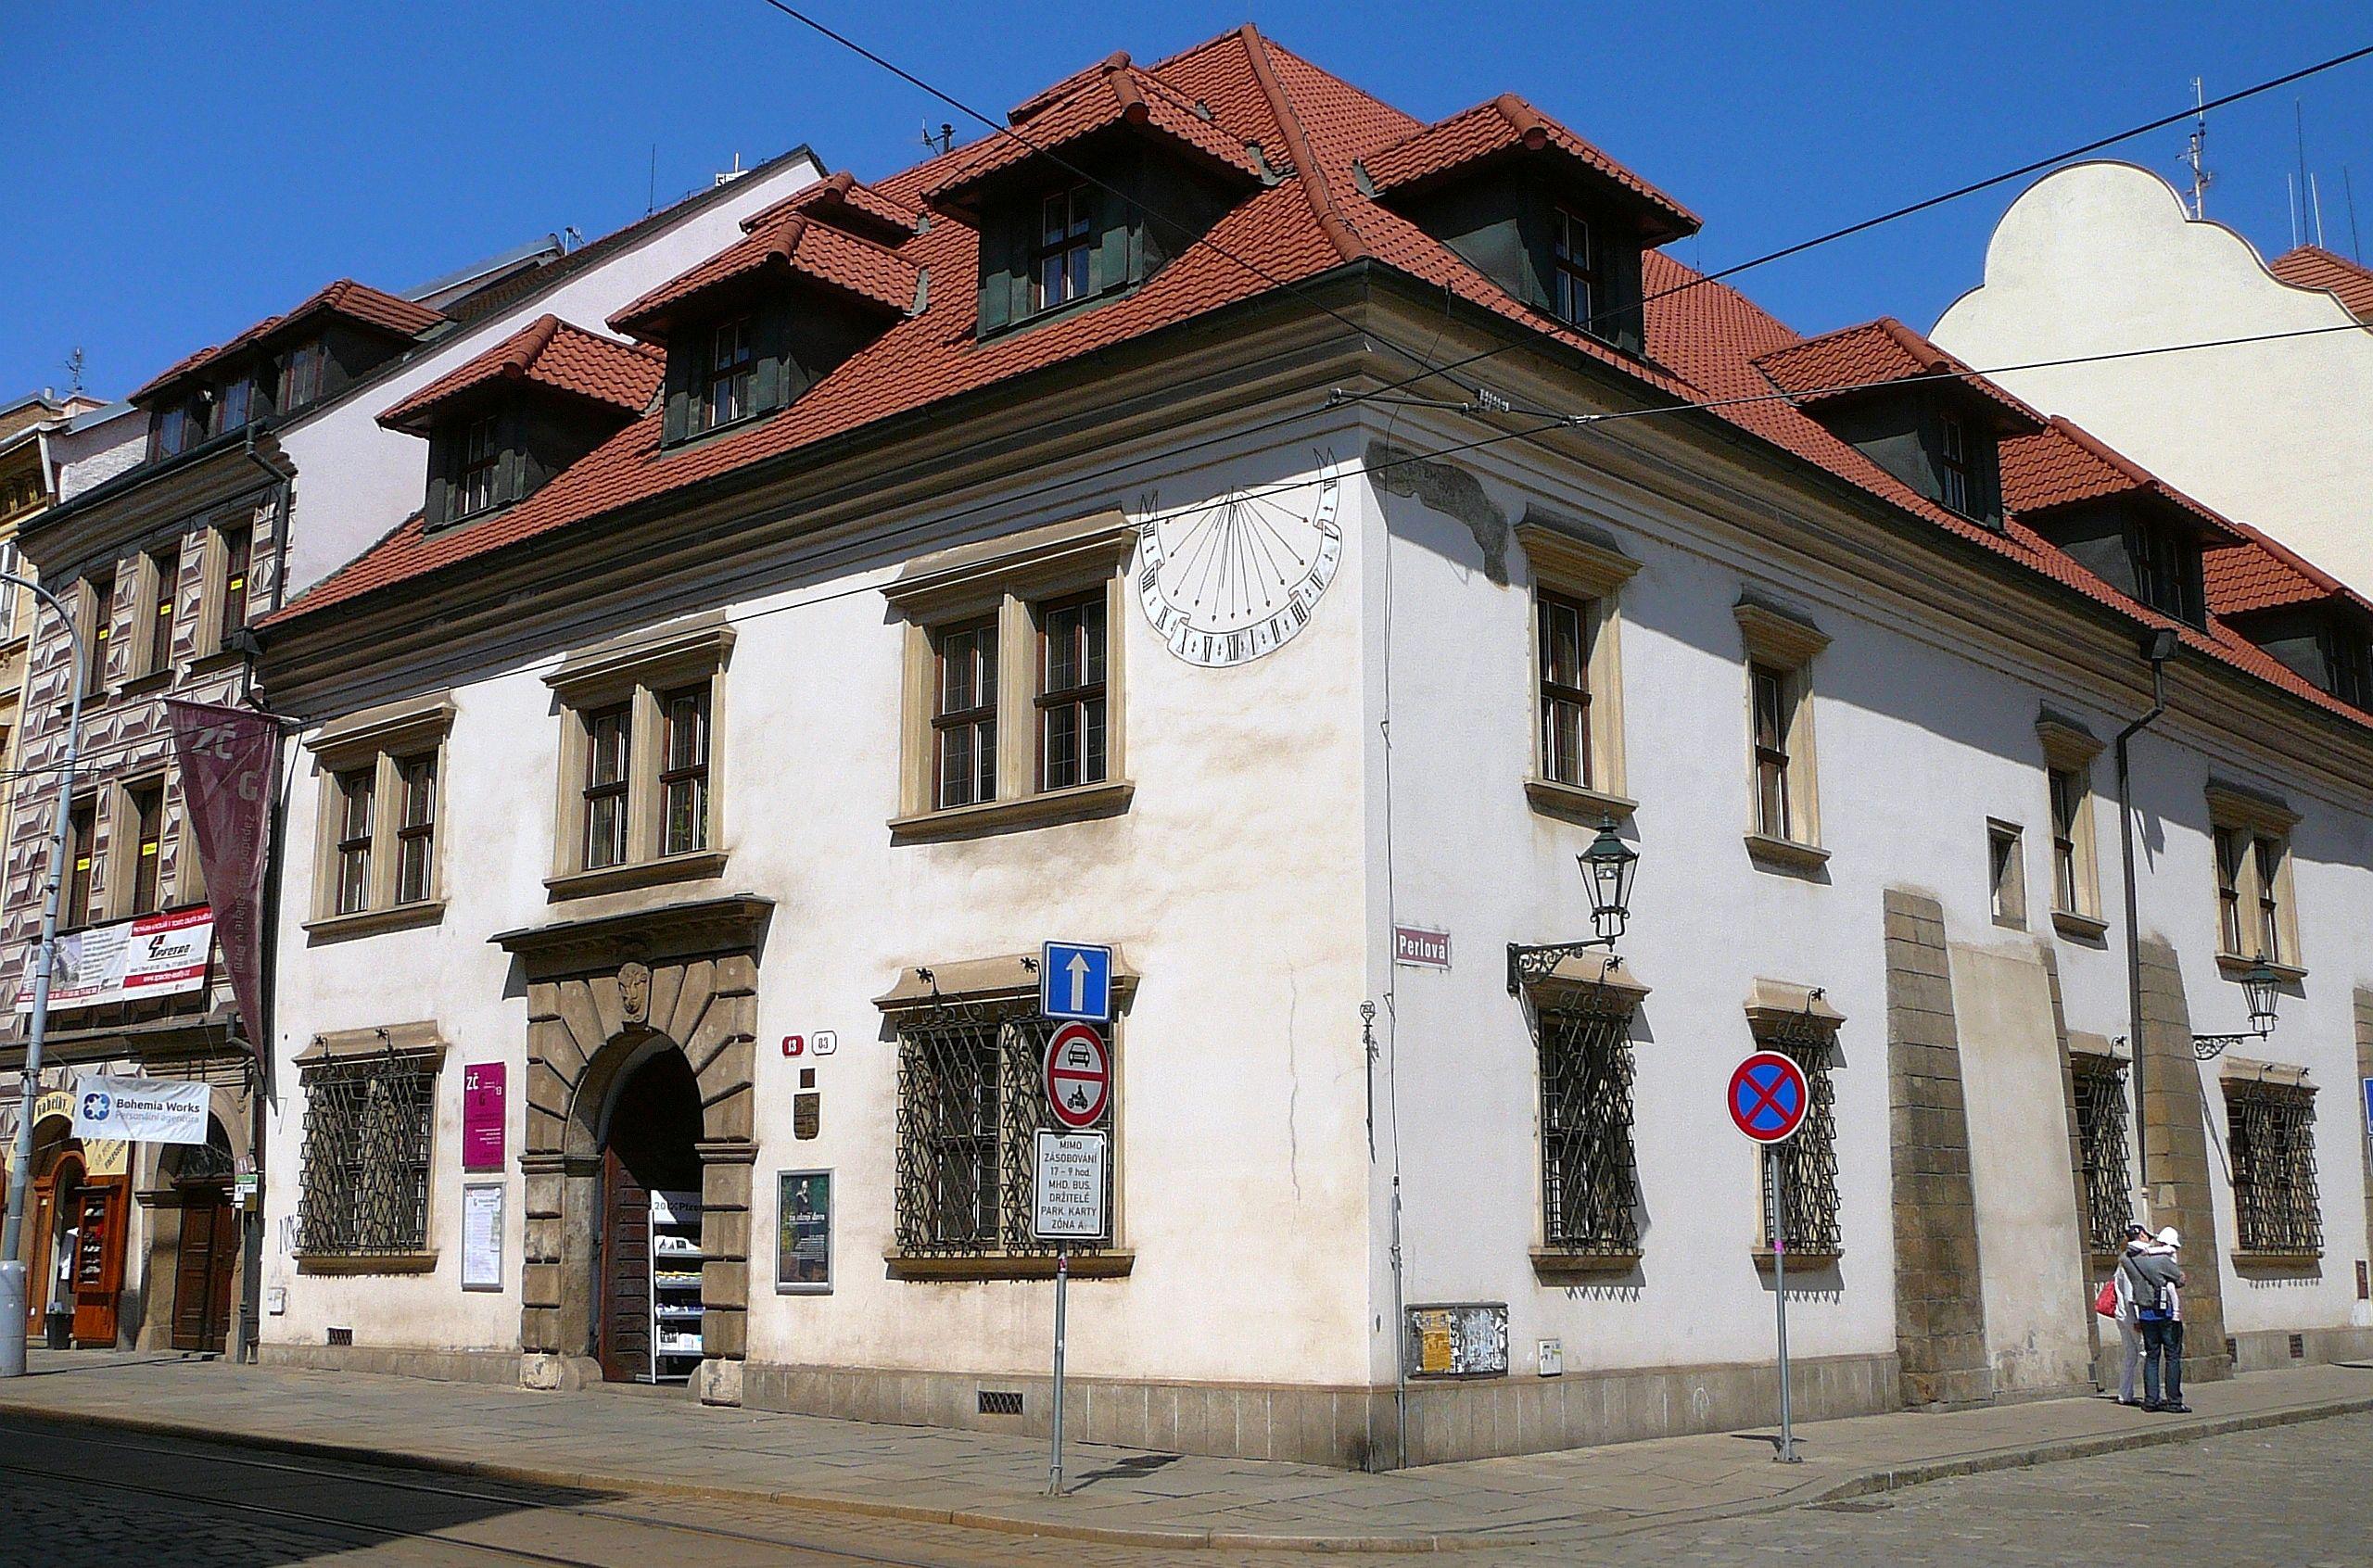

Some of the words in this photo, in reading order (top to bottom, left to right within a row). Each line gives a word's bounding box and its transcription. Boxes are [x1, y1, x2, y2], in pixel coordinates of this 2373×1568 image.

[191, 723, 237, 760] ZČ
[238, 770, 261, 801] G
[1399, 934, 1445, 959] Perlová
[788, 1039, 797, 1053] 13
[466, 1072, 479, 1091] ZČ
[116, 1098, 163, 1110] Bohemia
[166, 1102, 200, 1113] Works
[1059, 1140, 1083, 1150] MIMO
[1044, 1151, 1098, 1164] ZÁSOBOVÁNÍ
[1050, 1167, 1059, 1176] 17
[1049, 1191, 1090, 1204] DRŽITELÉ
[1068, 1207, 1098, 1217] KARTY
[1051, 1218, 1075, 1230] ZÓNA
